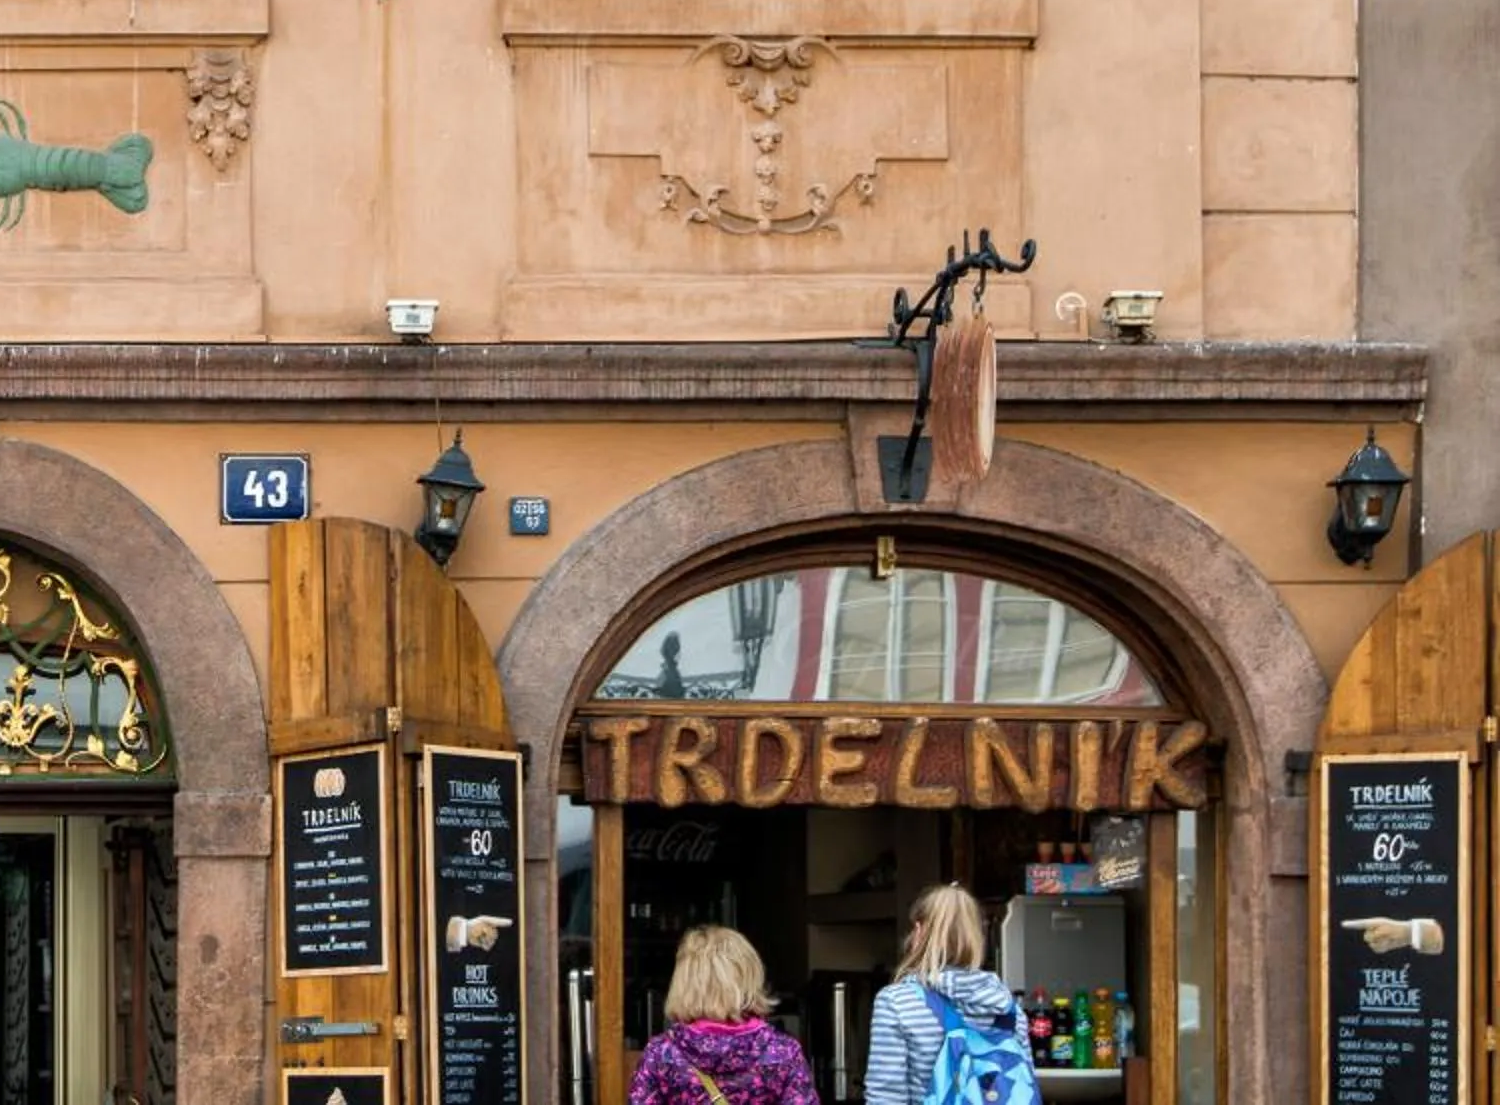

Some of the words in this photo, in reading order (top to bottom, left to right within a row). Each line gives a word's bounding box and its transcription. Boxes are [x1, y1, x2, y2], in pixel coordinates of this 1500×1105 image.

[243, 470, 288, 507] 43
[1349, 777, 1434, 804] TRDELNÍK
[302, 801, 362, 827] TRDELNÍK
[471, 829, 492, 856] 60
[1373, 833, 1404, 861] 60
[465, 964, 490, 982] HOT
[1363, 963, 1410, 984] TEPLÉ
[452, 986, 498, 1004] DRINKS
